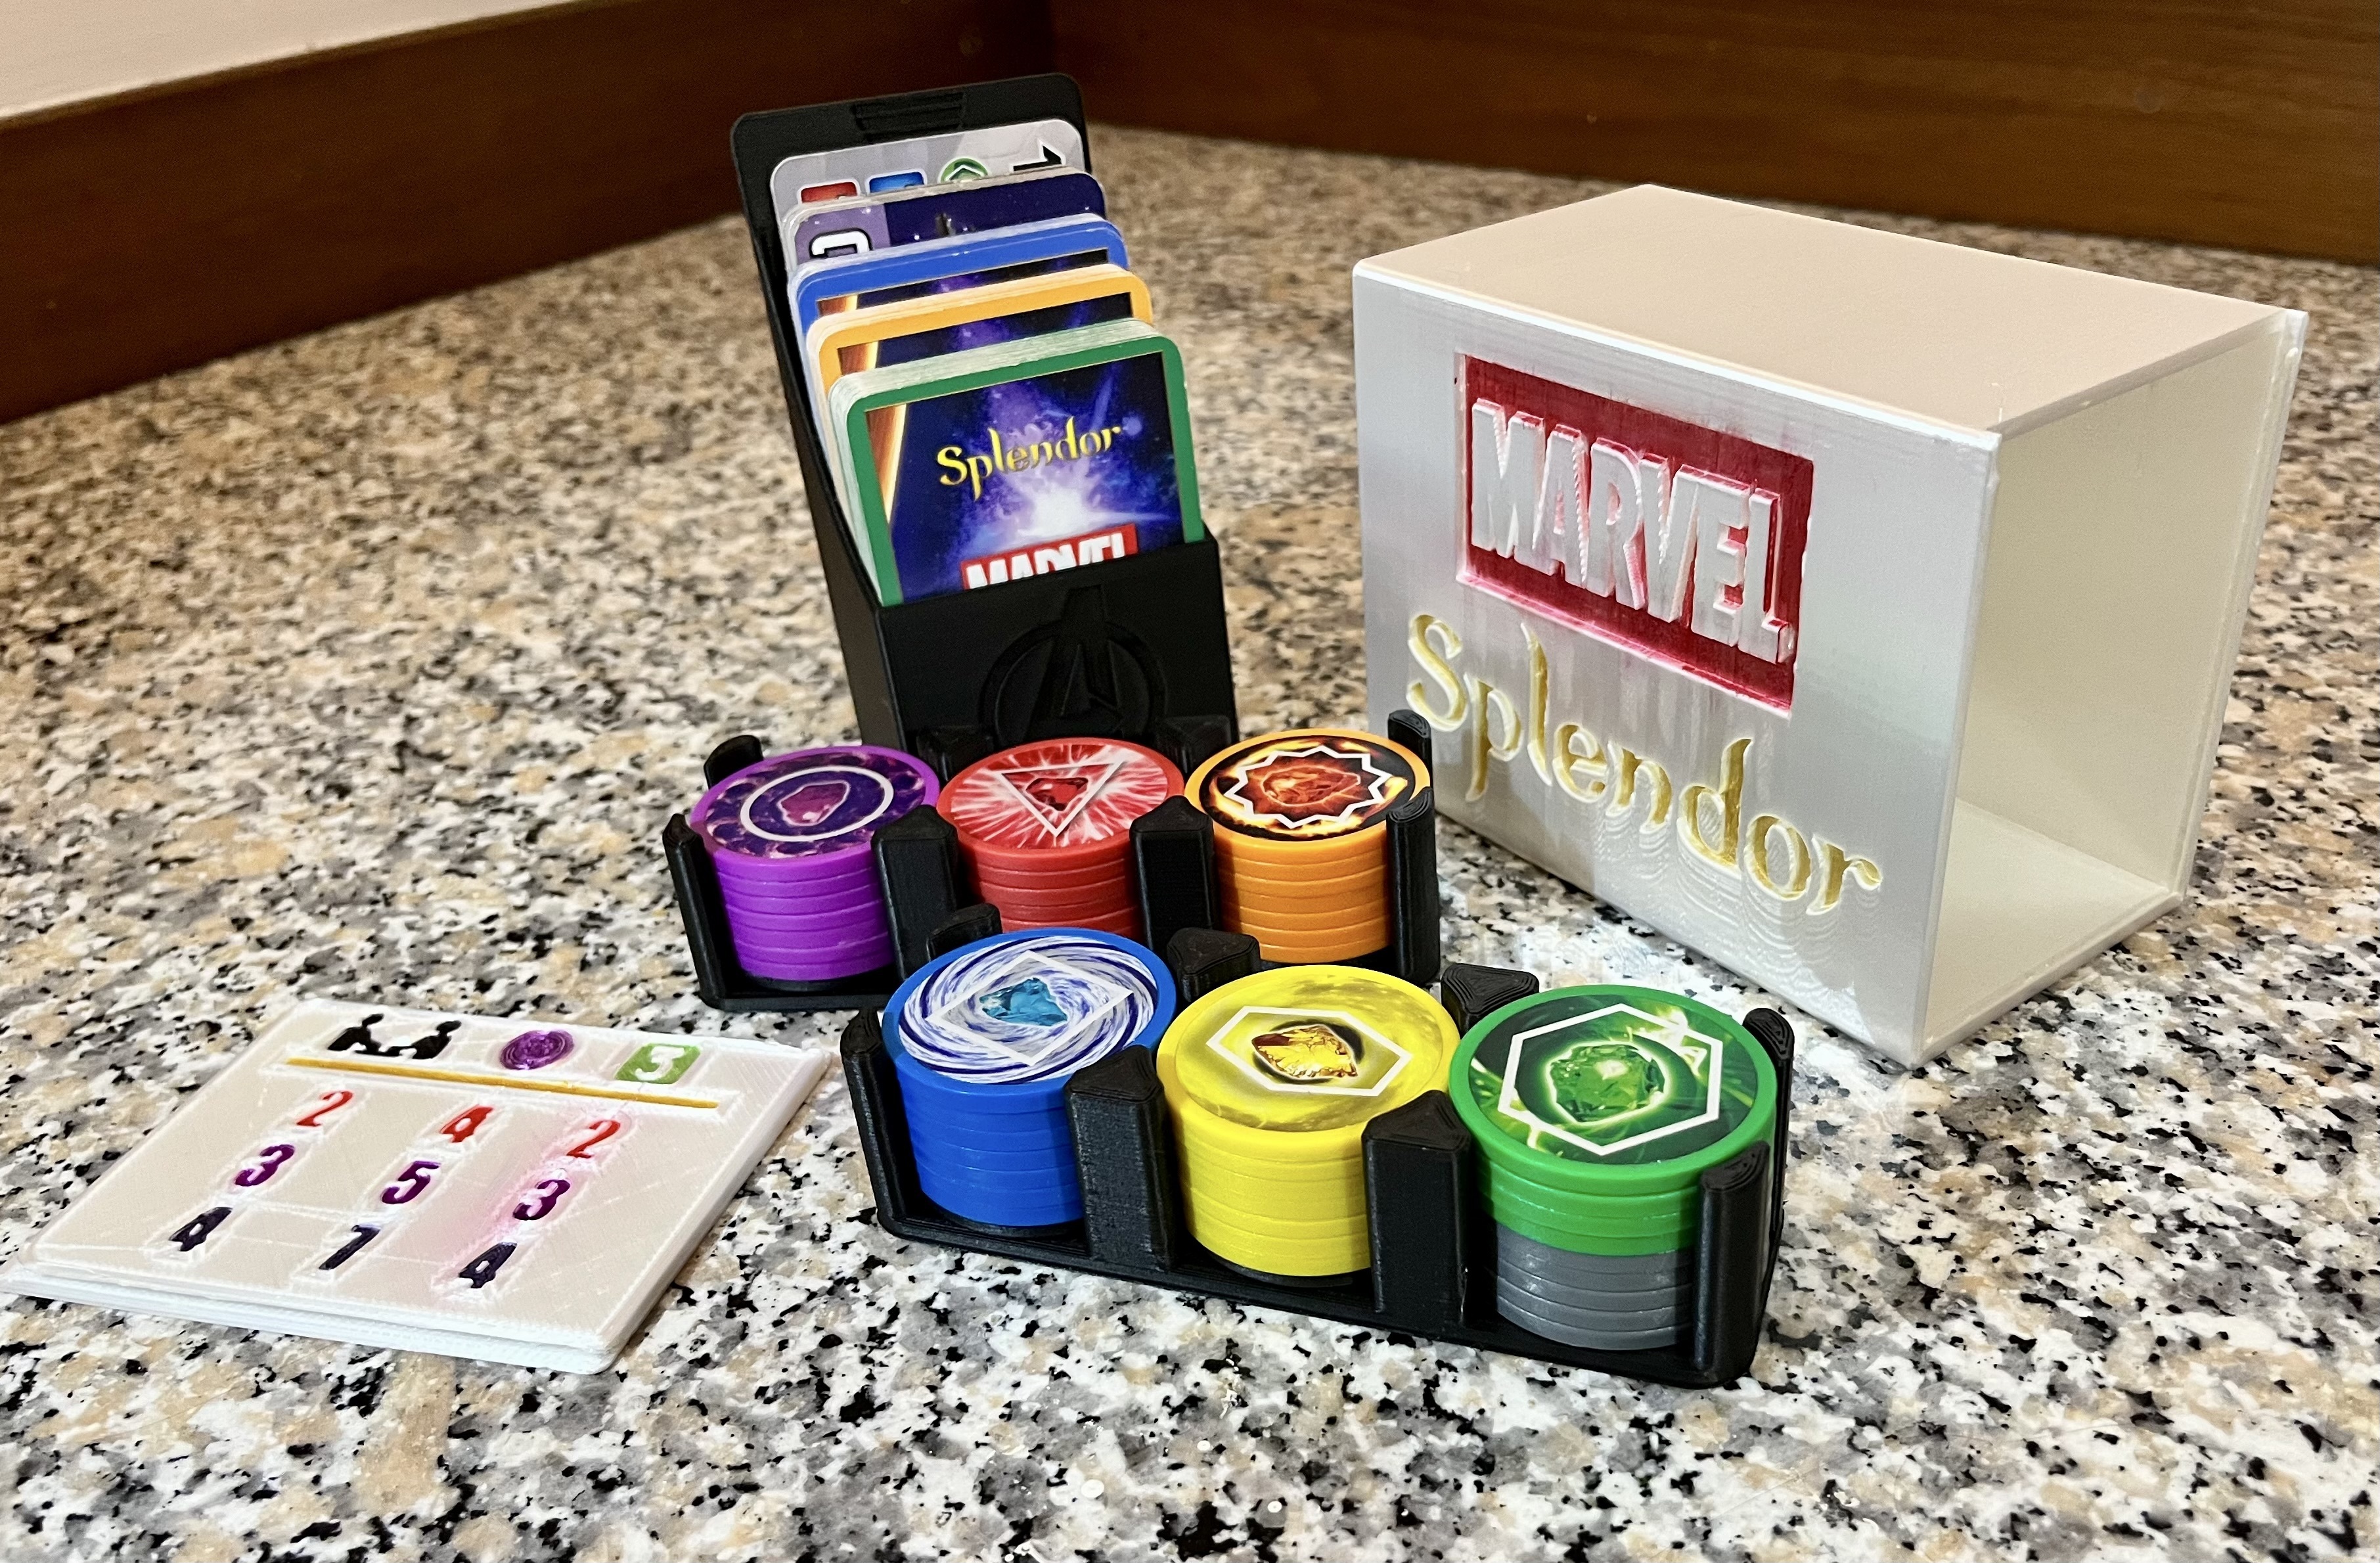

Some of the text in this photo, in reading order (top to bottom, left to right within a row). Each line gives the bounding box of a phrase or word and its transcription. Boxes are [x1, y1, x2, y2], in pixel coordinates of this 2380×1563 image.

[936, 416, 1122, 501] Splendor
[1469, 397, 1792, 664] MARVEL
[1405, 614, 1884, 916] Splendor
[635, 1046, 685, 1081] 5
[296, 1091, 621, 1159] 2 4 2
[235, 1144, 571, 1221] 3 5 3
[169, 1206, 233, 1252] 4
[458, 1242, 516, 1288] 4
